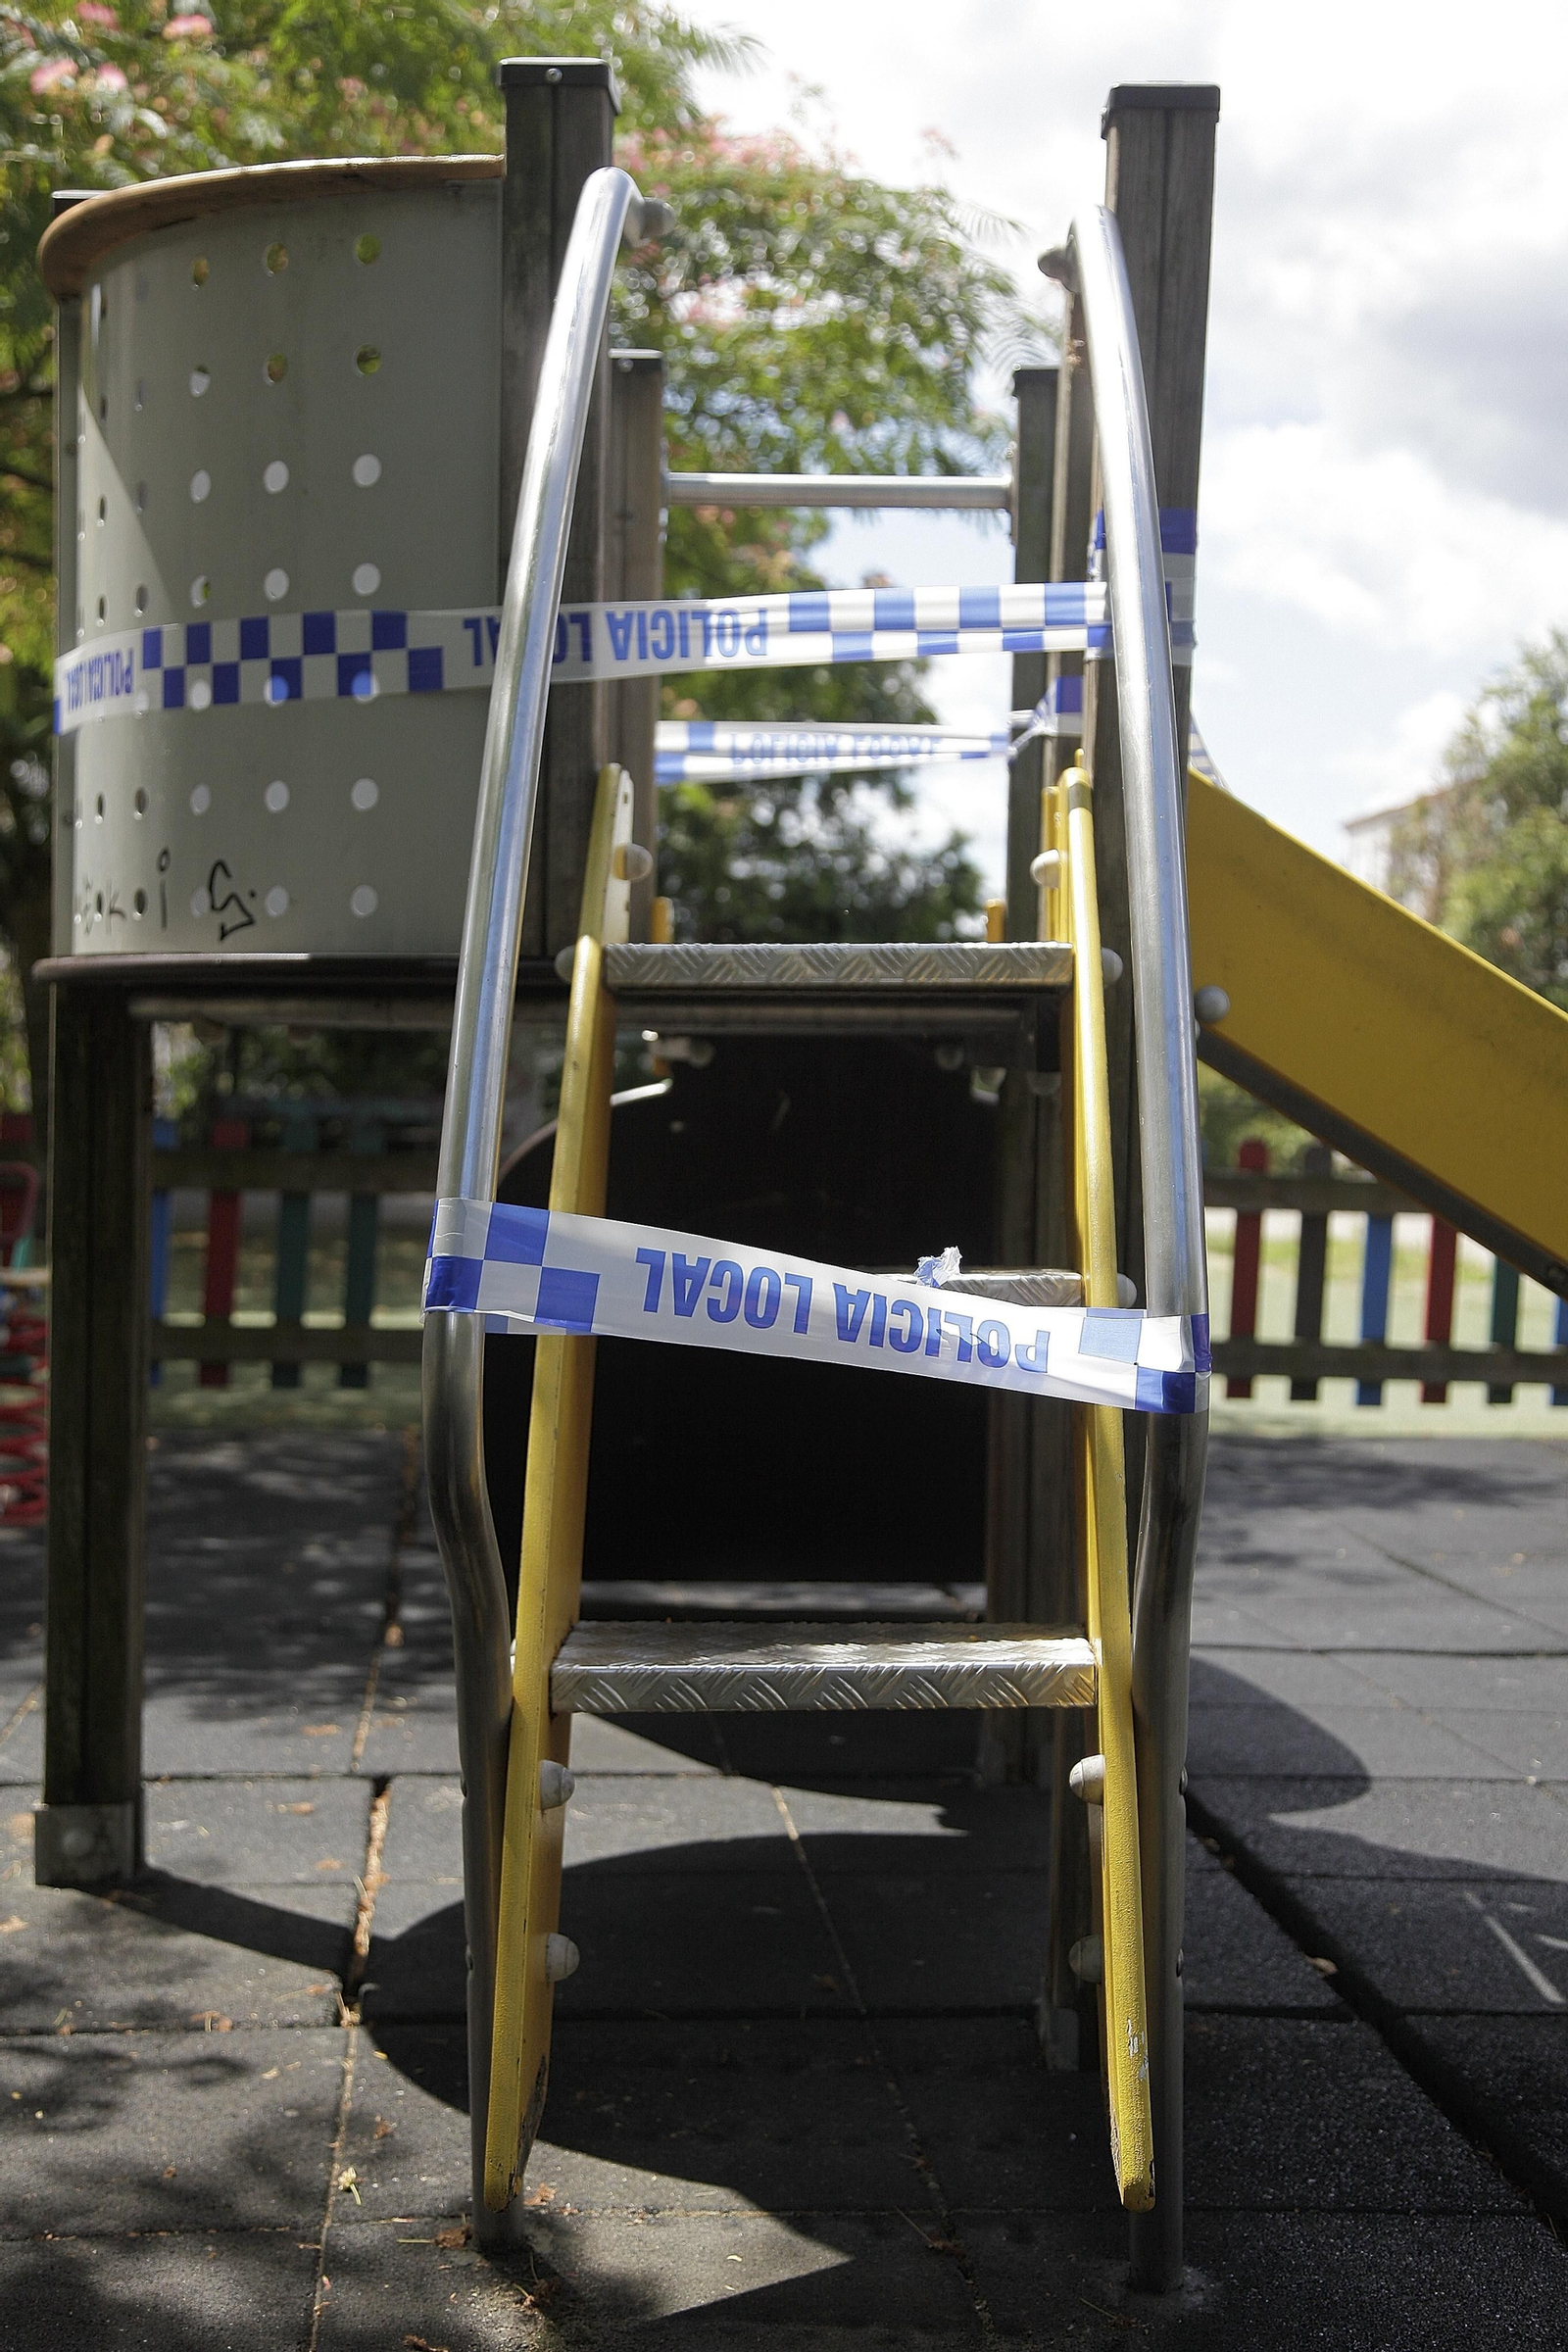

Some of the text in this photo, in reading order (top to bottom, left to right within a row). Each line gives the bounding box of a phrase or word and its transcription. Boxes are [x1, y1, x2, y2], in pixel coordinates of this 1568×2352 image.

[604, 607, 769, 662] POLICIA
[635, 1247, 1051, 1374] POLICIA LOCAL
